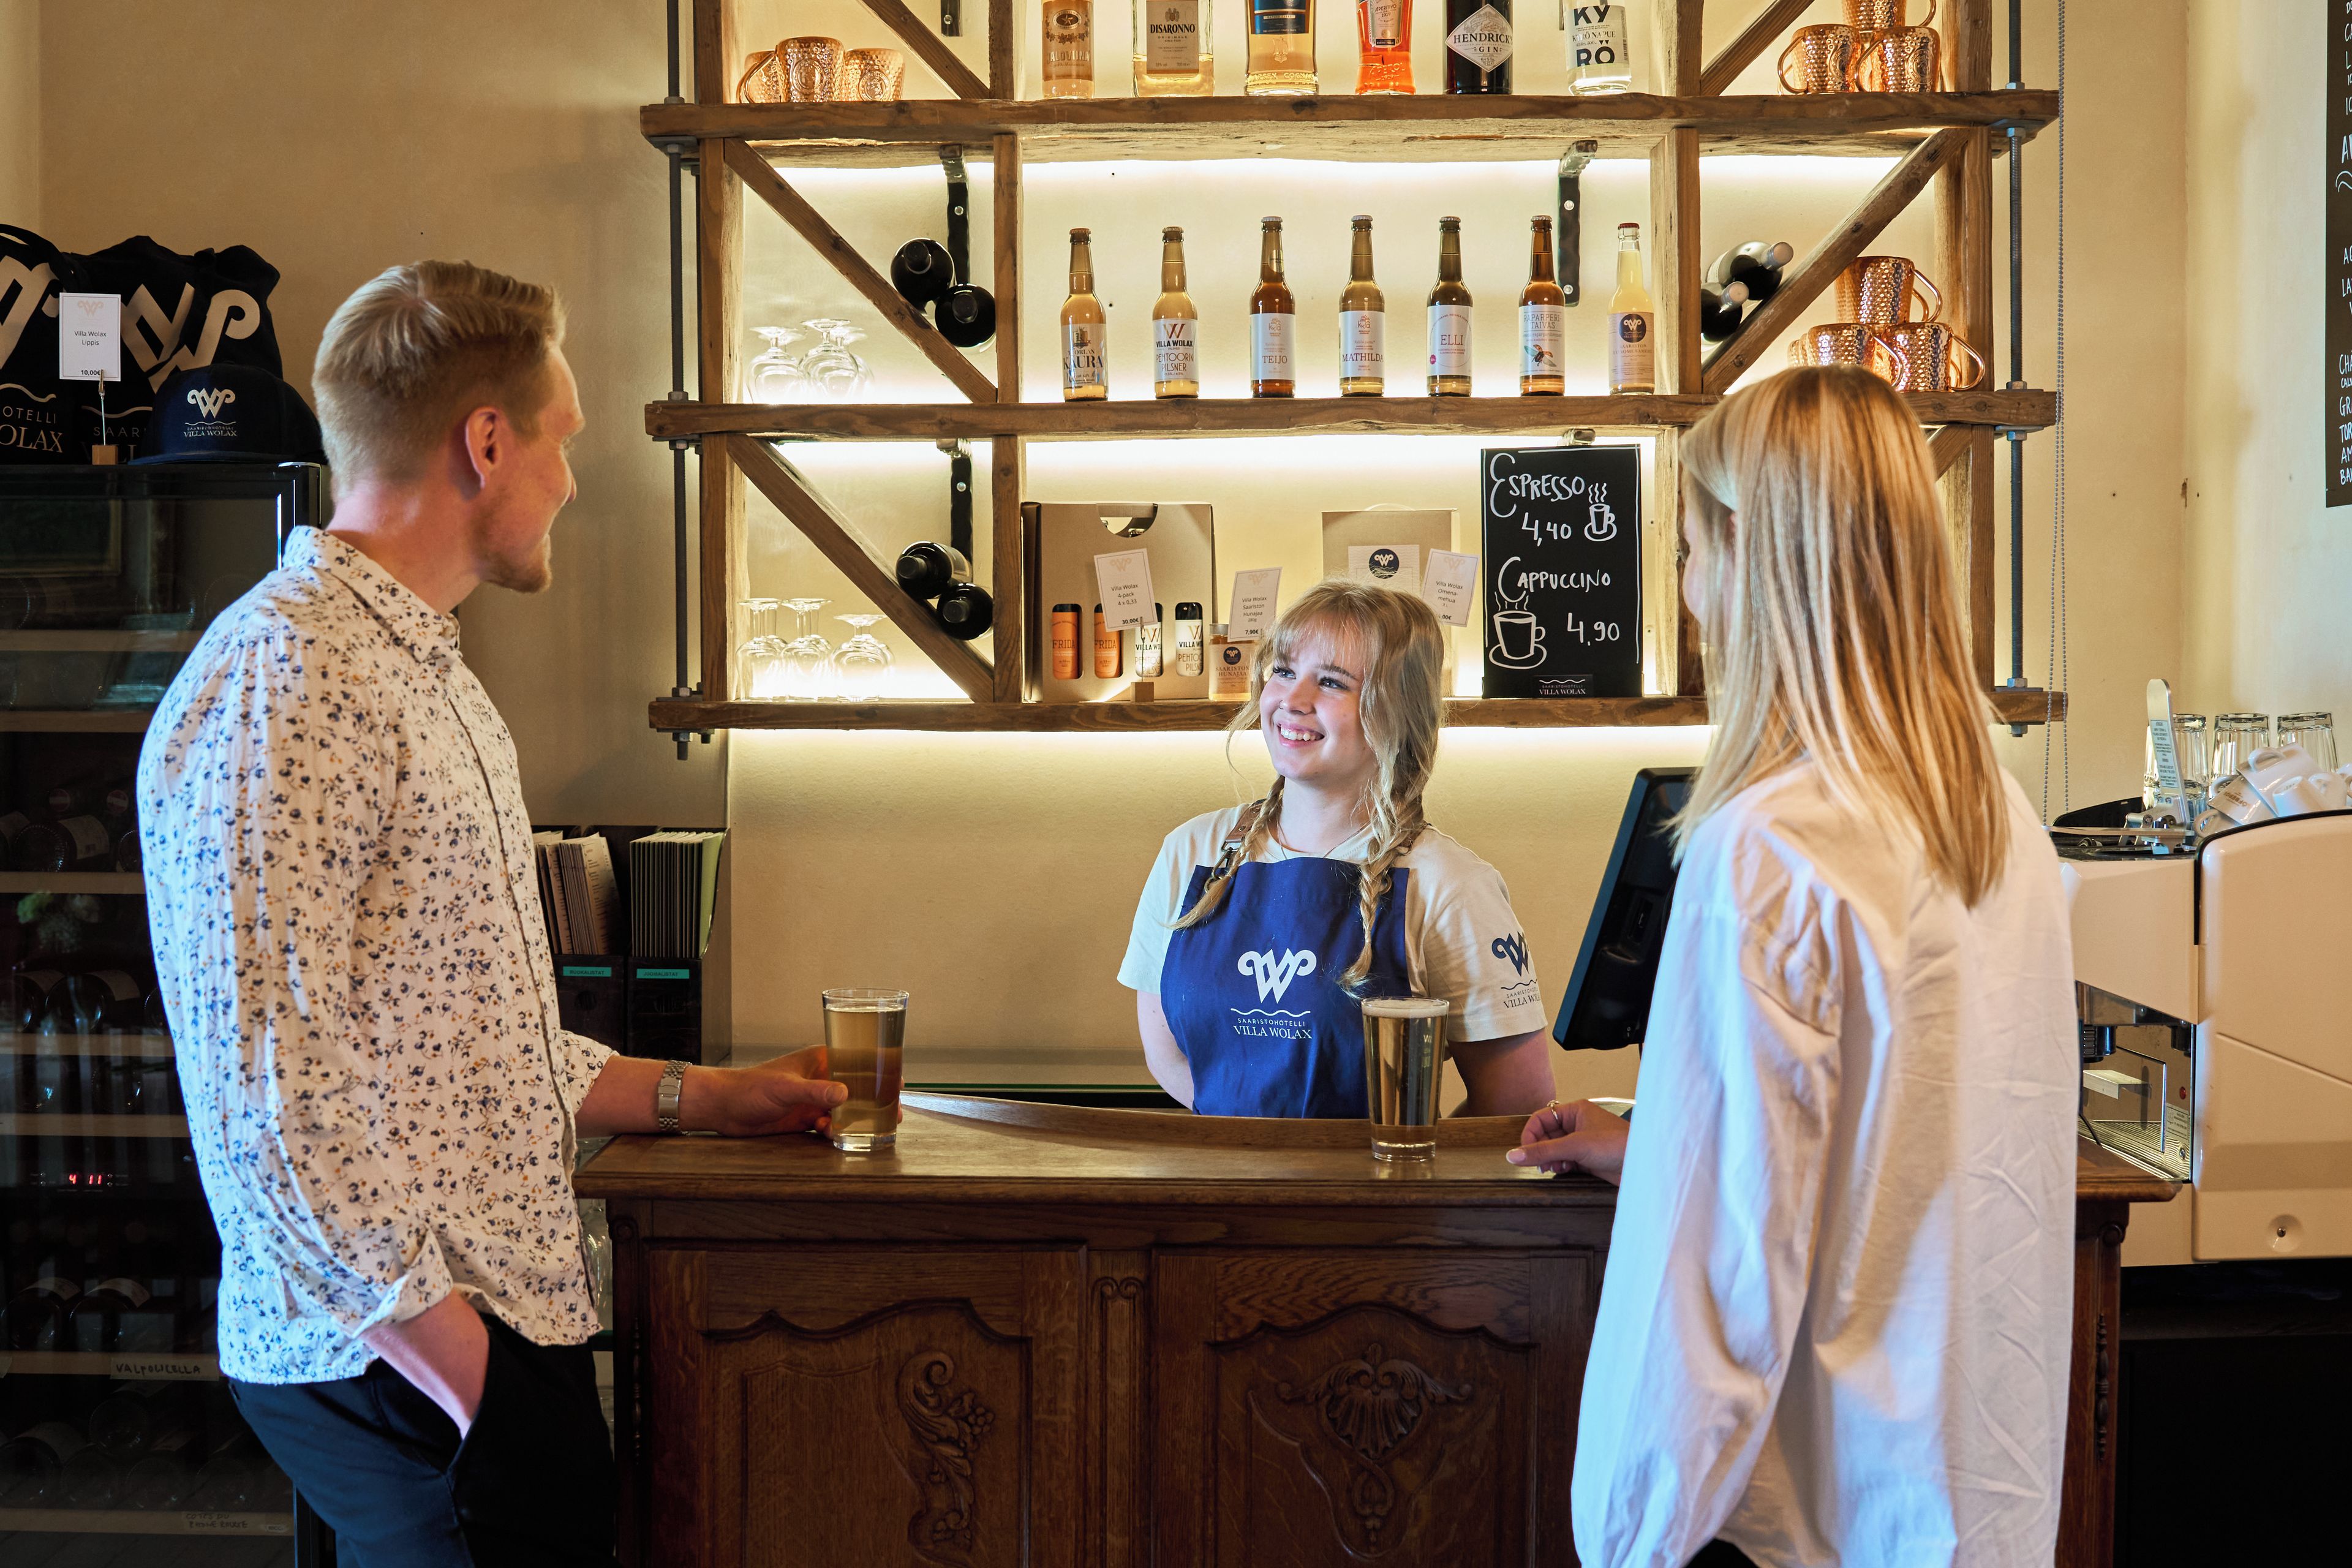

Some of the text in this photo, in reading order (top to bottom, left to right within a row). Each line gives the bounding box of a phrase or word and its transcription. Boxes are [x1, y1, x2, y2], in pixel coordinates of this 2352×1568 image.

[1150, 23, 1196, 34] DISARONNO
[1440, 334, 1463, 345] ELLI
[1262, 355, 1287, 364] TEIJO
[1342, 353, 1384, 363] MATHILDA
[1161, 363, 1187, 372] PILSNER
[1521, 512, 1572, 547] 4,40
[1052, 639, 1076, 649] FRIDA
[1095, 639, 1117, 649] FRIDA
[1503, 997, 1528, 1008] VILLA
[1237, 1018, 1305, 1027] SAARISTOHOTELLI
[1233, 1025, 1313, 1039] VILLA WOLAX
[116, 1363, 201, 1376] VALPOLICELLA
